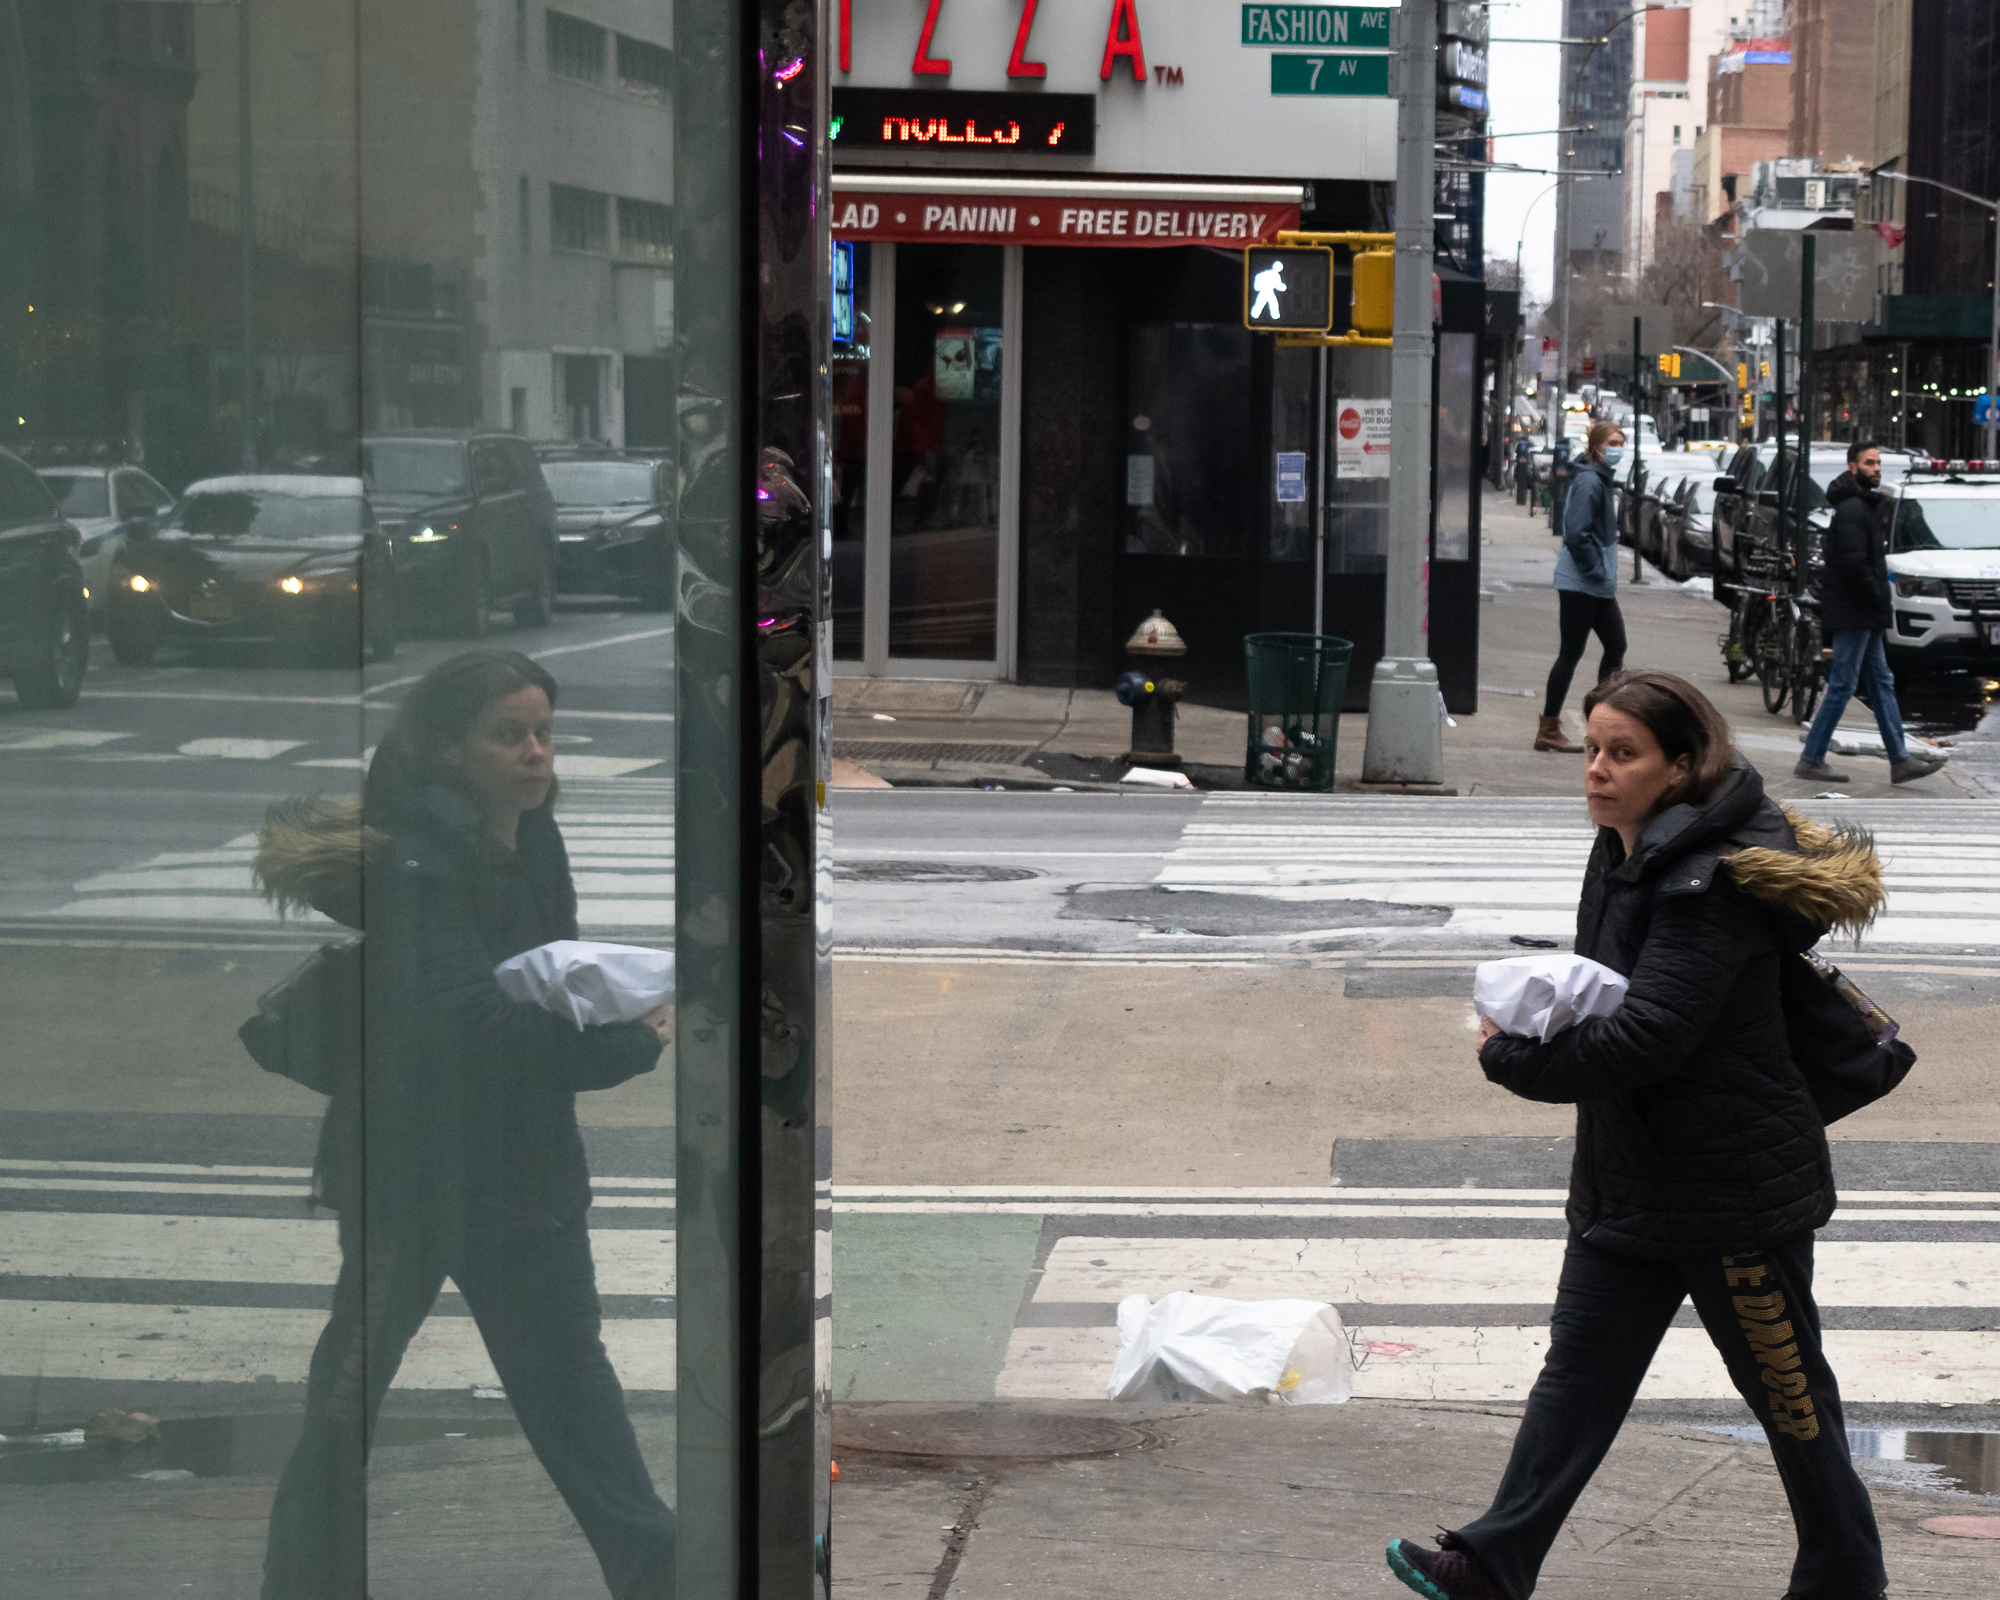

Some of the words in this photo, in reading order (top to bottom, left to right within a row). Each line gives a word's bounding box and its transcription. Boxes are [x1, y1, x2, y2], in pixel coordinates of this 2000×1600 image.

[1248, 8, 1348, 43] FASHION
[1360, 11, 1387, 29] AVE
[1306, 58, 1325, 91] 7
[1338, 59, 1358, 76] AV
[923, 205, 1017, 232] PANINI
[1061, 208, 1129, 235] FREE
[1135, 211, 1267, 238] DELIVERY
